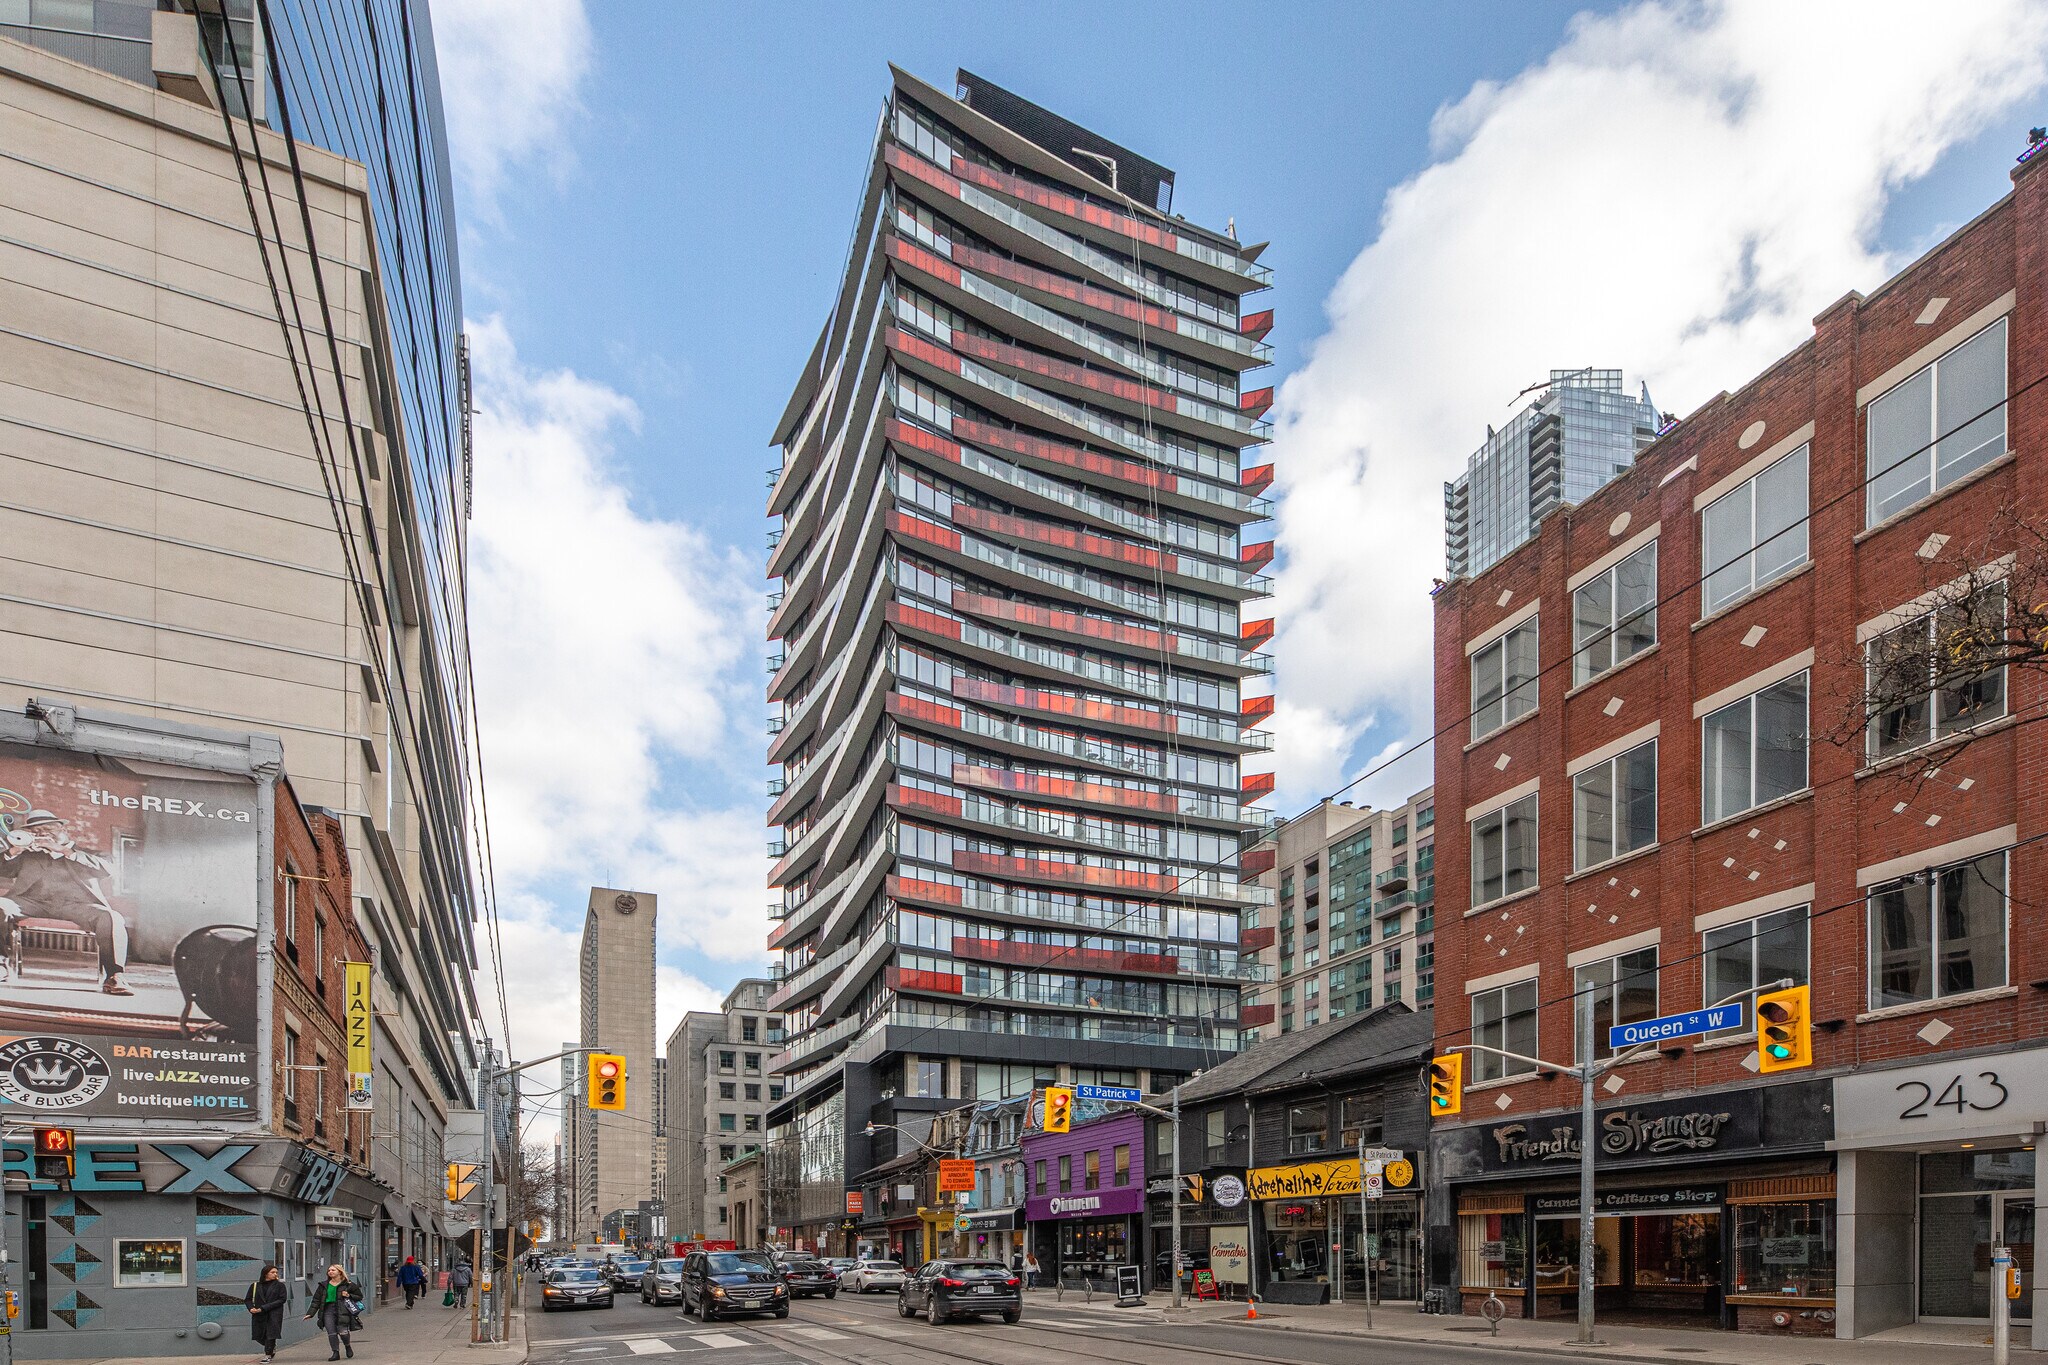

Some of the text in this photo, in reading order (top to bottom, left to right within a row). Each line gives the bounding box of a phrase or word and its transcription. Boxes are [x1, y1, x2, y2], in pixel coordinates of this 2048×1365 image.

[88, 789, 250, 823] theREX.ca
[350, 981, 366, 1048] JAZZ
[1624, 1011, 1724, 1042] Queen St W
[0, 1040, 101, 1068] THE REX
[113, 1045, 246, 1063] BARrestaurant
[123, 1068, 251, 1085] liveJAZZvenue
[19, 1093, 30, 1103] &
[35, 1093, 83, 1107] BLUES
[81, 1076, 103, 1096] BAR
[117, 1093, 249, 1109] boutiqueHOTEL
[1083, 1086, 1093, 1096] St
[1096, 1087, 1127, 1099] Patrick
[1896, 1071, 2009, 1120] 243
[1601, 1111, 1732, 1154] Stranger
[3, 1143, 260, 1194] REX
[301, 1149, 316, 1166] THE
[1376, 1151, 1391, 1159] Patrick
[297, 1157, 349, 1205] REX
[1249, 1168, 1322, 1199] Adrenaline
[1285, 1207, 1305, 1215] OPEN
[1211, 1244, 1247, 1257] Cannabis
